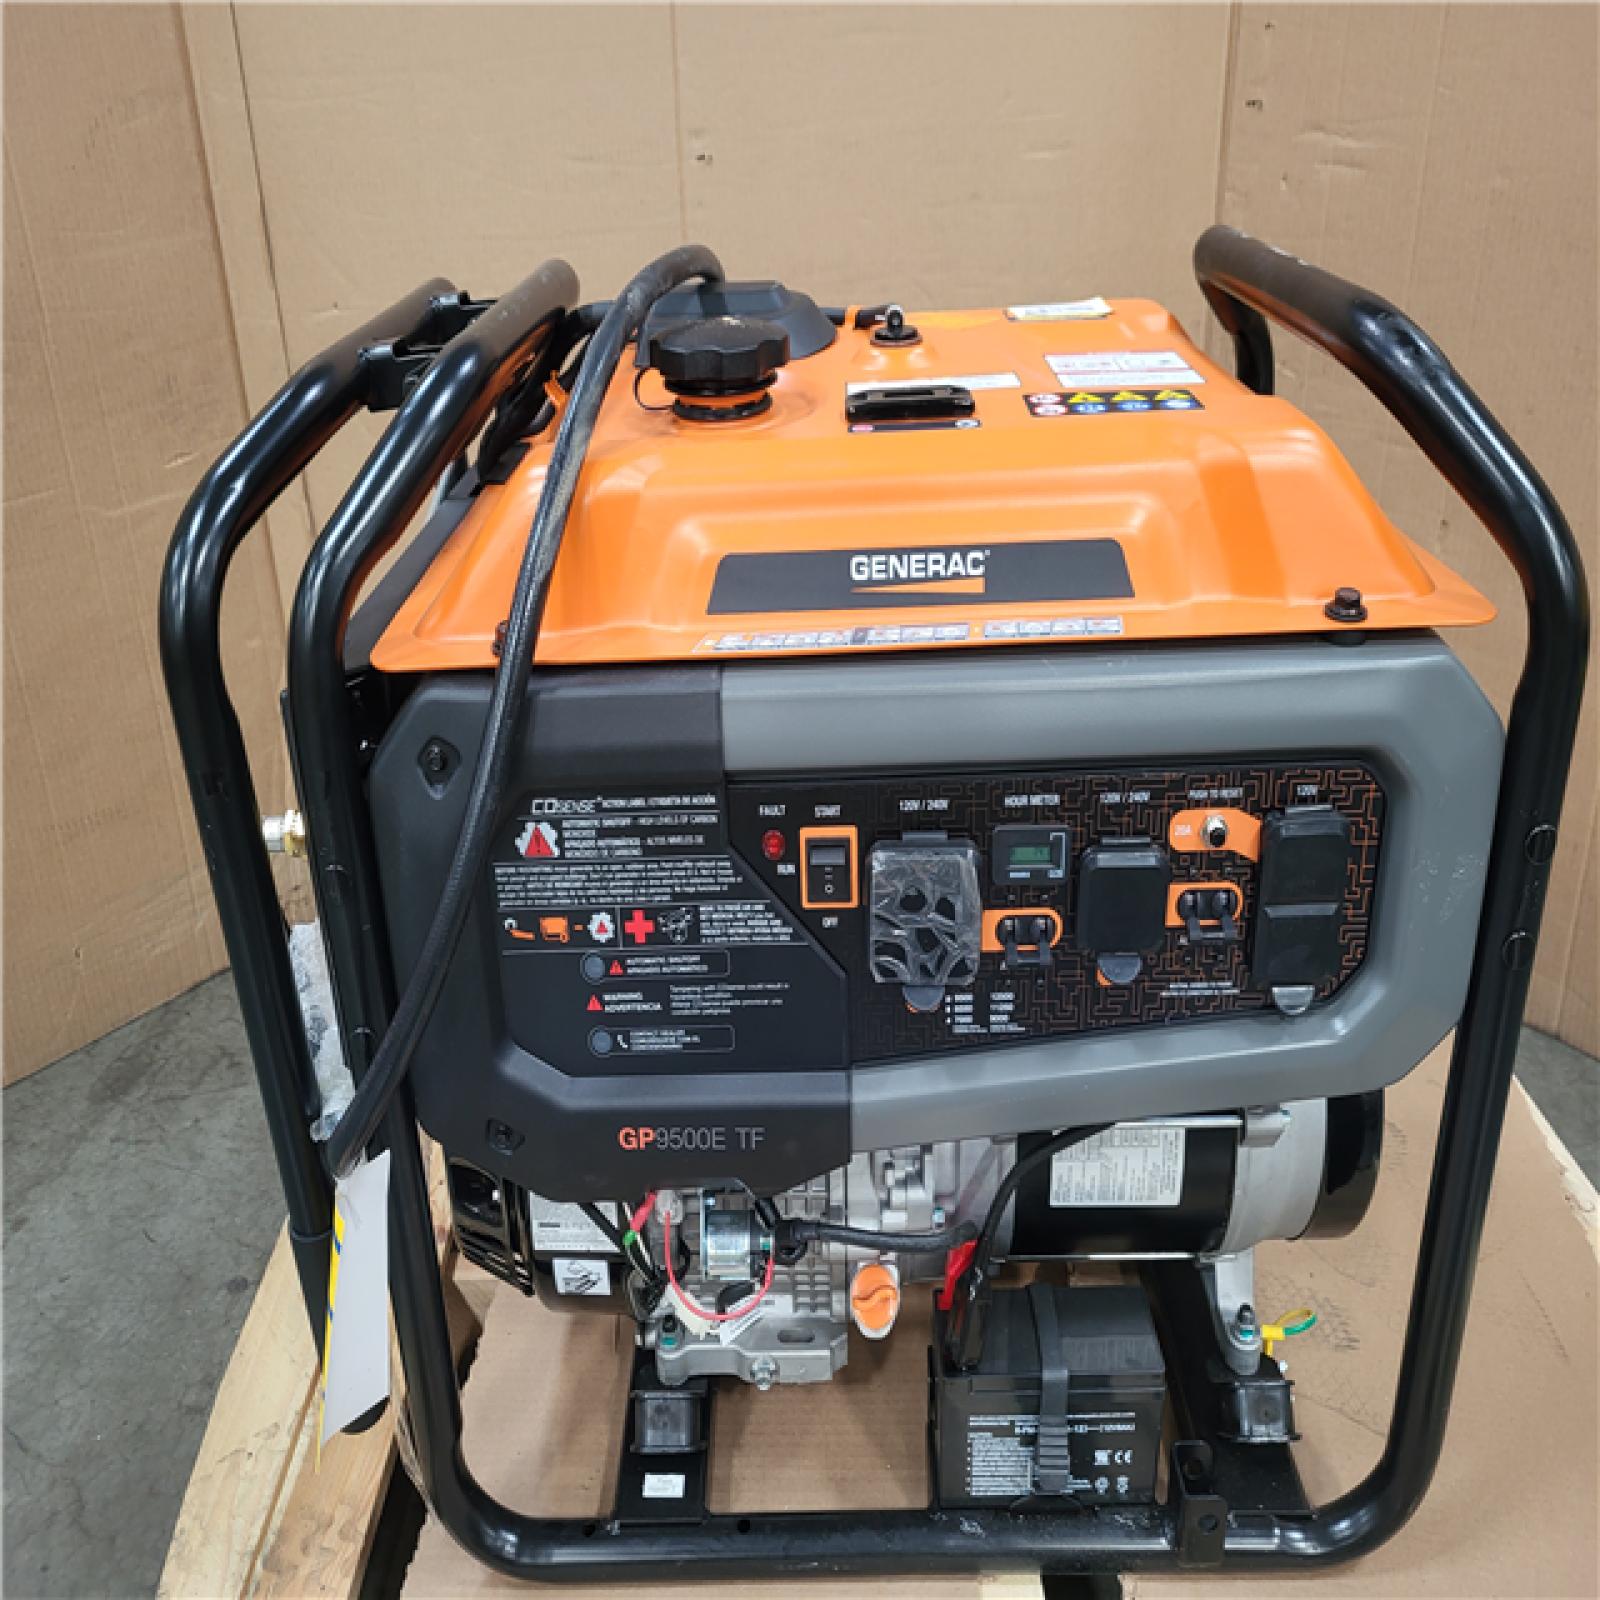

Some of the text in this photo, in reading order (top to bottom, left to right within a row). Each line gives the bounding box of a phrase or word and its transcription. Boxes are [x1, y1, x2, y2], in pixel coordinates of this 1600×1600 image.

[850, 549, 986, 581] GENERAC
[618, 1126, 765, 1151] GP9500E TF
